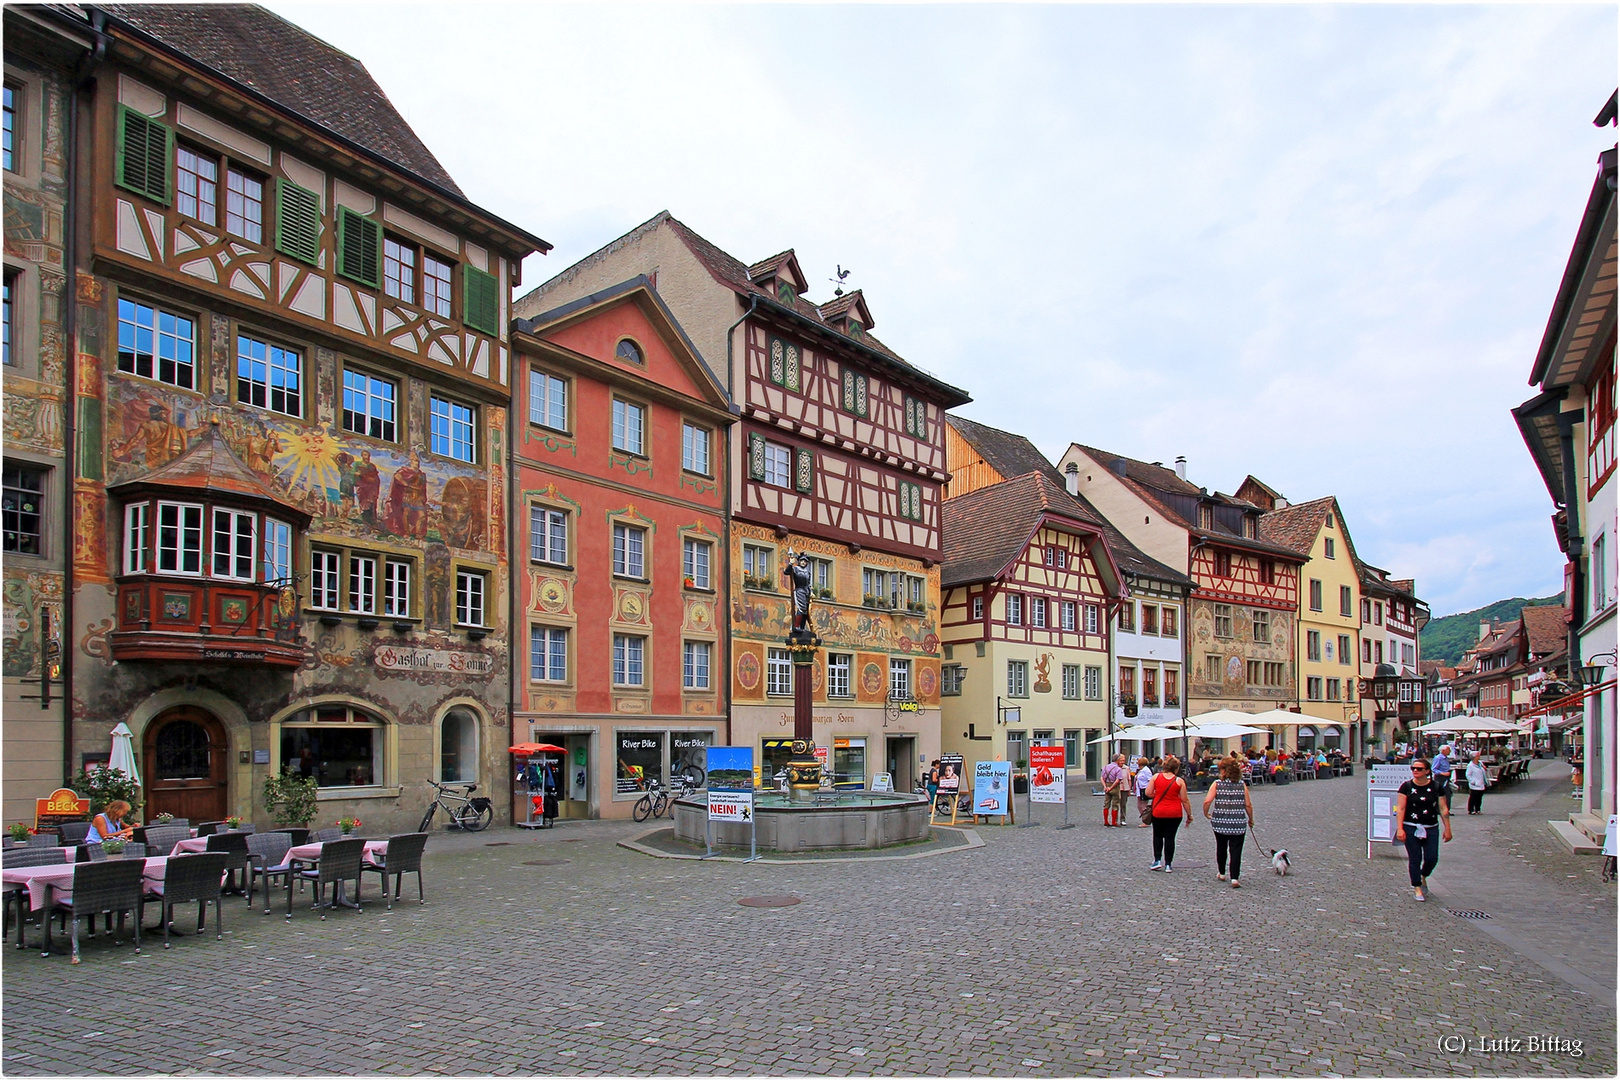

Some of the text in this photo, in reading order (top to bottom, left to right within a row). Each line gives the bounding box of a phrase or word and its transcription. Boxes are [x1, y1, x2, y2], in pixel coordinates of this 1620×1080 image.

[381, 648, 432, 667] Gasthof
[448, 653, 488, 671] Sonne
[899, 702, 918, 712] Volg
[837, 712, 855, 723] Horn
[622, 740, 657, 749] River Bike
[674, 739, 705, 748] River Bike
[977, 763, 992, 771] Geld
[1042, 773, 1063, 783] Nein!
[47, 801, 80, 811] BECK
[710, 803, 737, 815] NEIN!
